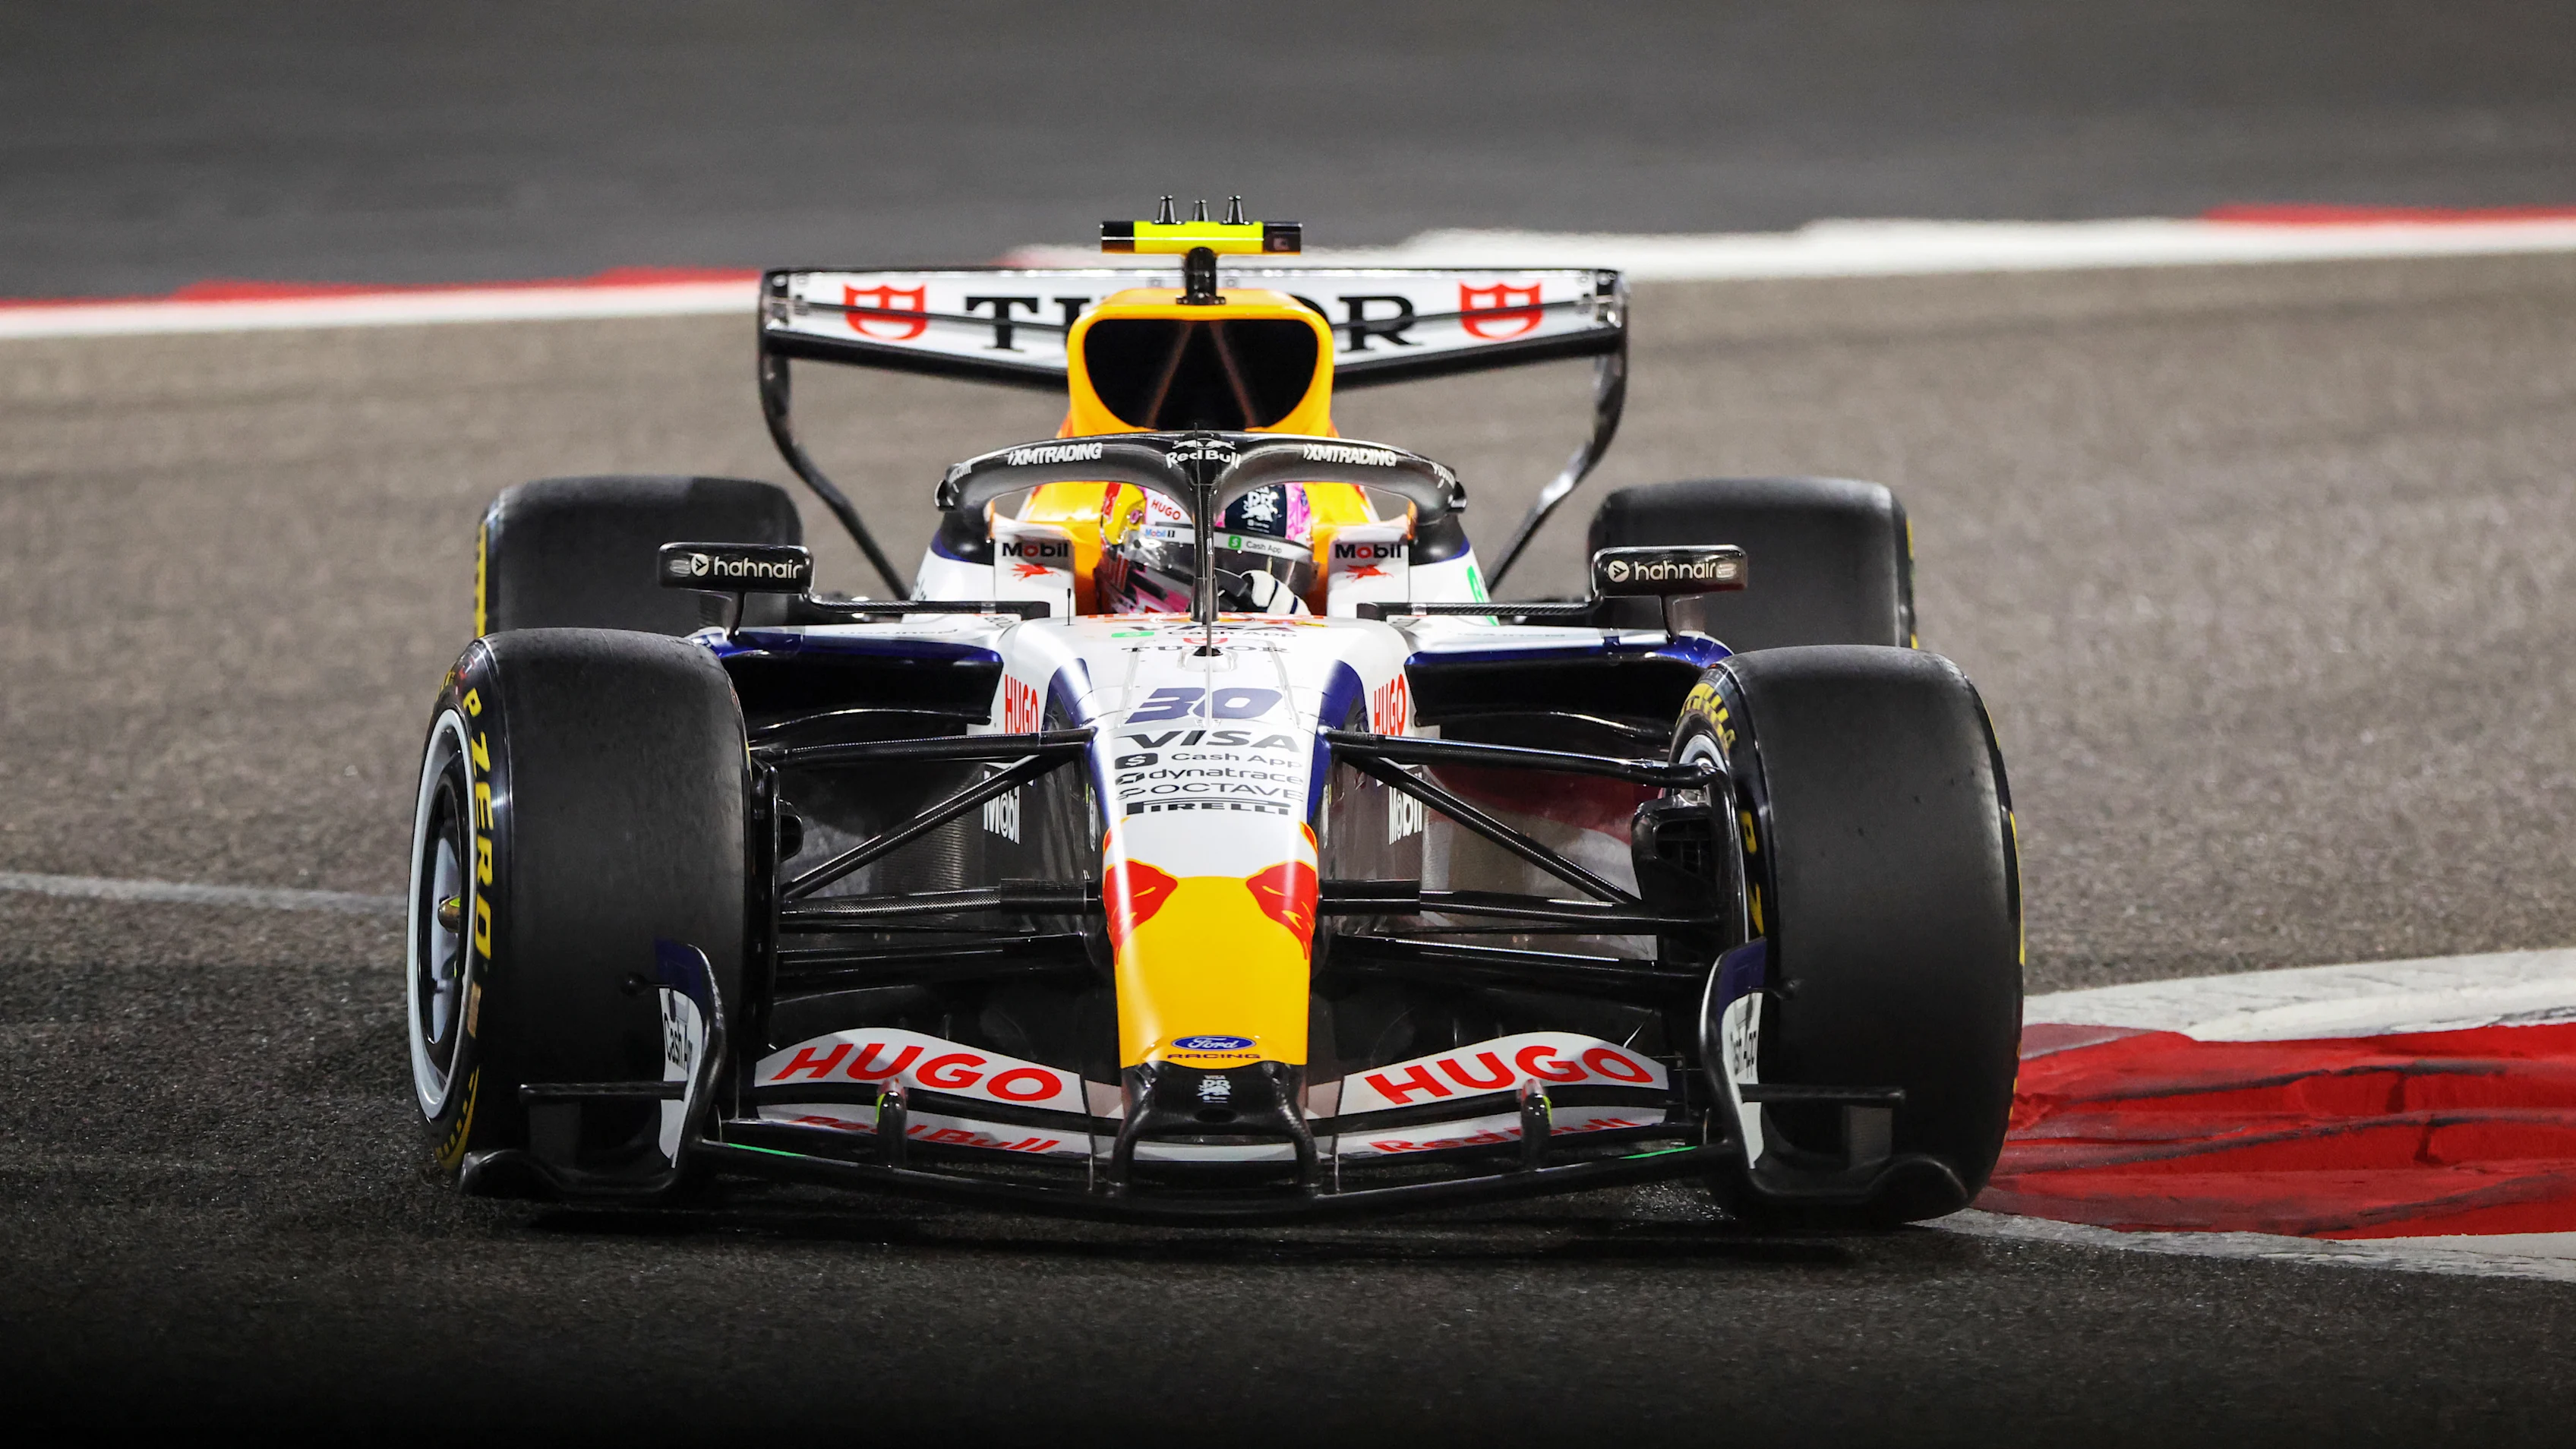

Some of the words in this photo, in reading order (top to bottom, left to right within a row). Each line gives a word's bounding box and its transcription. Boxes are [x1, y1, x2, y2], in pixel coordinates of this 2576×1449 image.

[1166, 450, 1203, 469] Red
[1205, 450, 1242, 469] Bull
[1151, 499, 1182, 521] HUGO
[1145, 529, 1166, 538] Mobil
[1002, 542, 1069, 558] Mobil
[1246, 540, 1265, 551] Cash
[1266, 544, 1283, 554] App
[1335, 544, 1403, 559] Mobil
[714, 556, 803, 579] hahnair
[1634, 560, 1716, 581] hahnair
[1121, 646, 1290, 654] TUOR
[462, 687, 482, 717] P
[1005, 674, 1038, 734] HUGO
[1125, 687, 1283, 724] 30
[1374, 674, 1406, 737] HUGO
[1115, 730, 1301, 753] VISA
[1171, 753, 1240, 762] Cash
[1247, 754, 1303, 769] App
[1149, 769, 1304, 785] dynatrace
[1151, 783, 1304, 801] OCTAVE
[1126, 797, 1291, 816] PIRELLI
[470, 731, 494, 960] ZERO
[1188, 1036, 1239, 1049] Ford
[771, 1043, 1062, 1101] HUGO
[1365, 1045, 1653, 1105] HUGO
